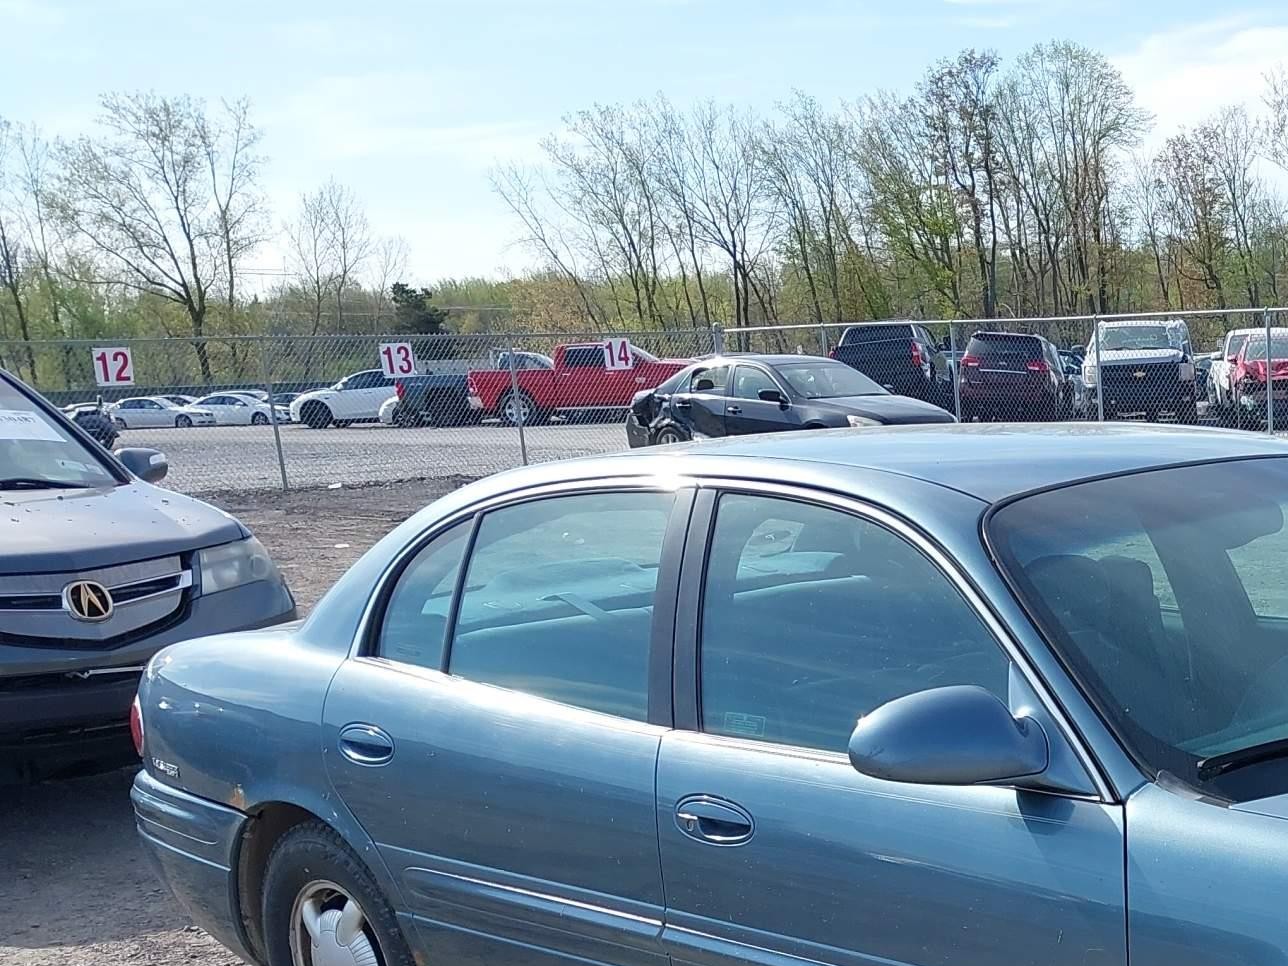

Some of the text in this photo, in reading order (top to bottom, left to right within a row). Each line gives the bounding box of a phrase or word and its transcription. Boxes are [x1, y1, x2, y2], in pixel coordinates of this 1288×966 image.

[96, 351, 131, 382] 12
[382, 345, 412, 374] 13
[605, 340, 630, 367] 14
